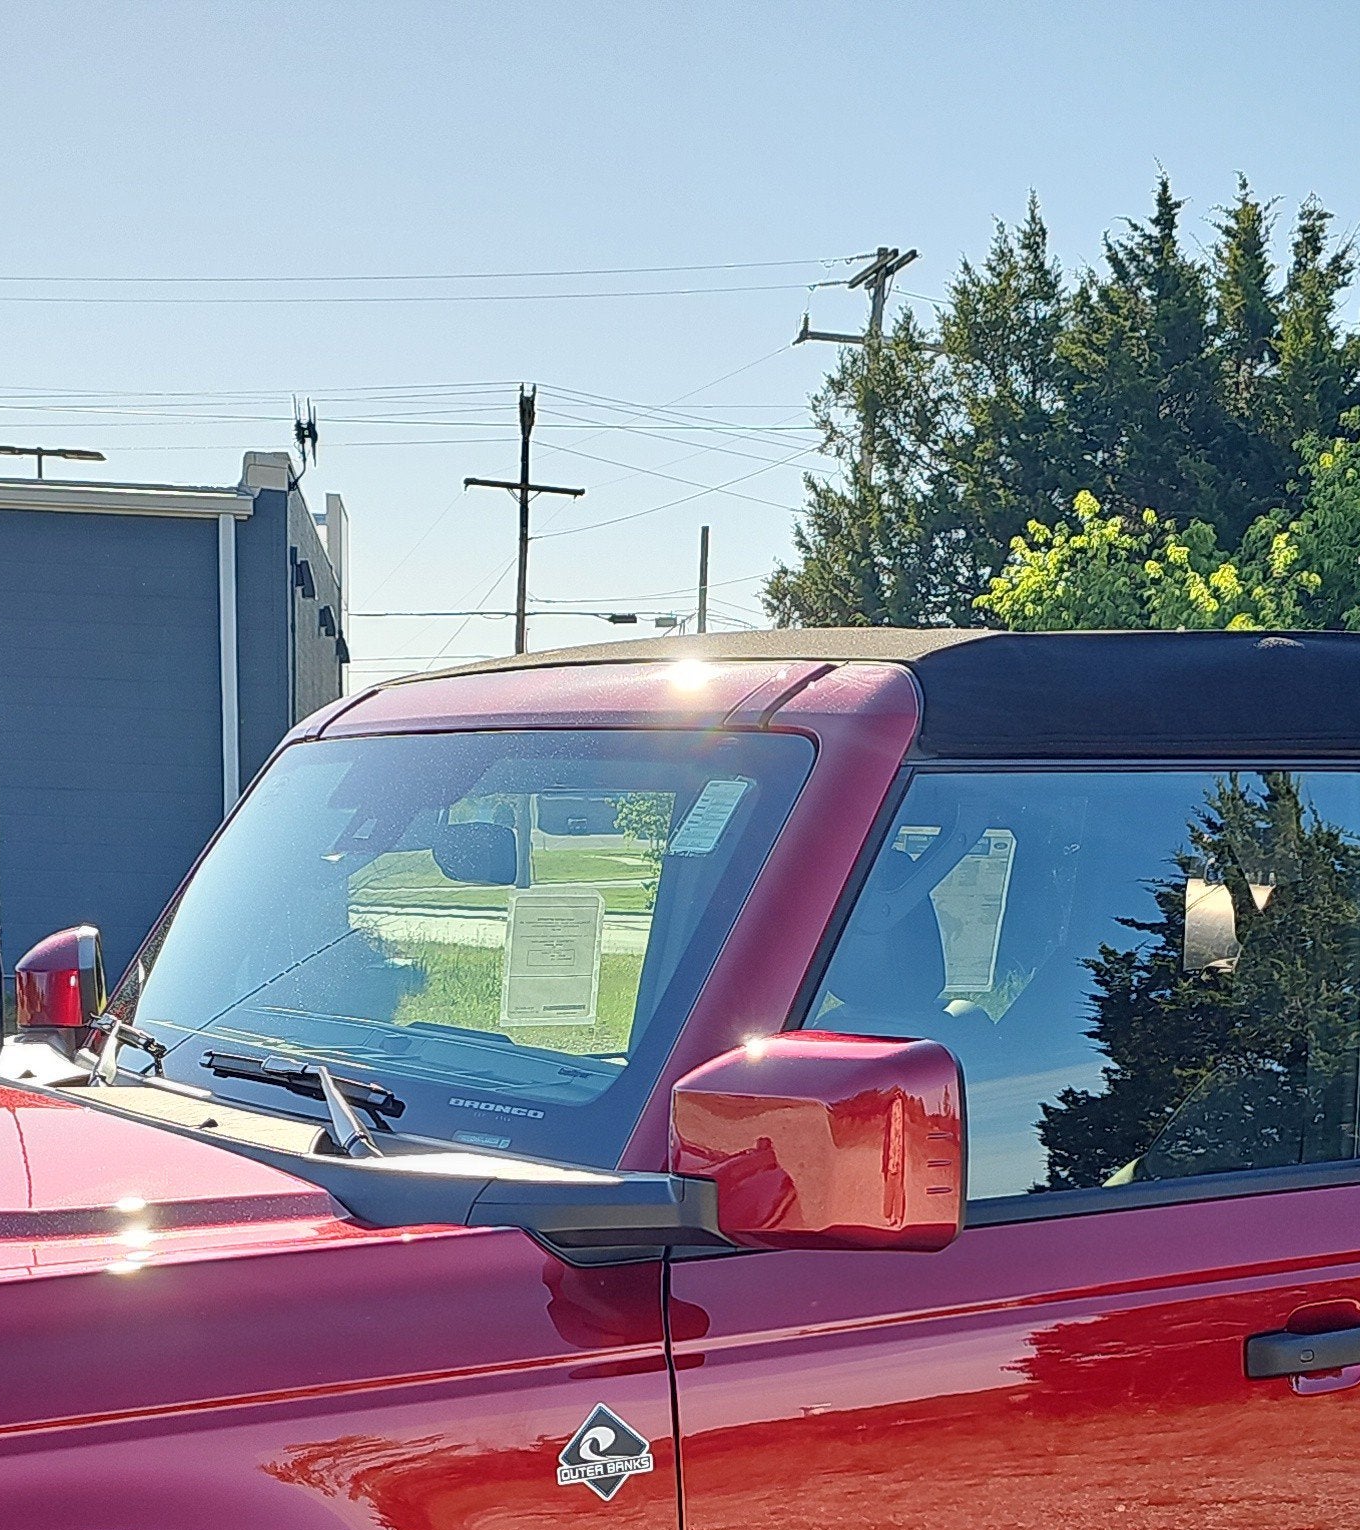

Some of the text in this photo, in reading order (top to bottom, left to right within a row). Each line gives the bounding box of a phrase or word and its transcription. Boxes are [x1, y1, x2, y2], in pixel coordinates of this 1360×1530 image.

[449, 1097, 545, 1119] BRONCO
[561, 1457, 650, 1481] OUTER BANKS
